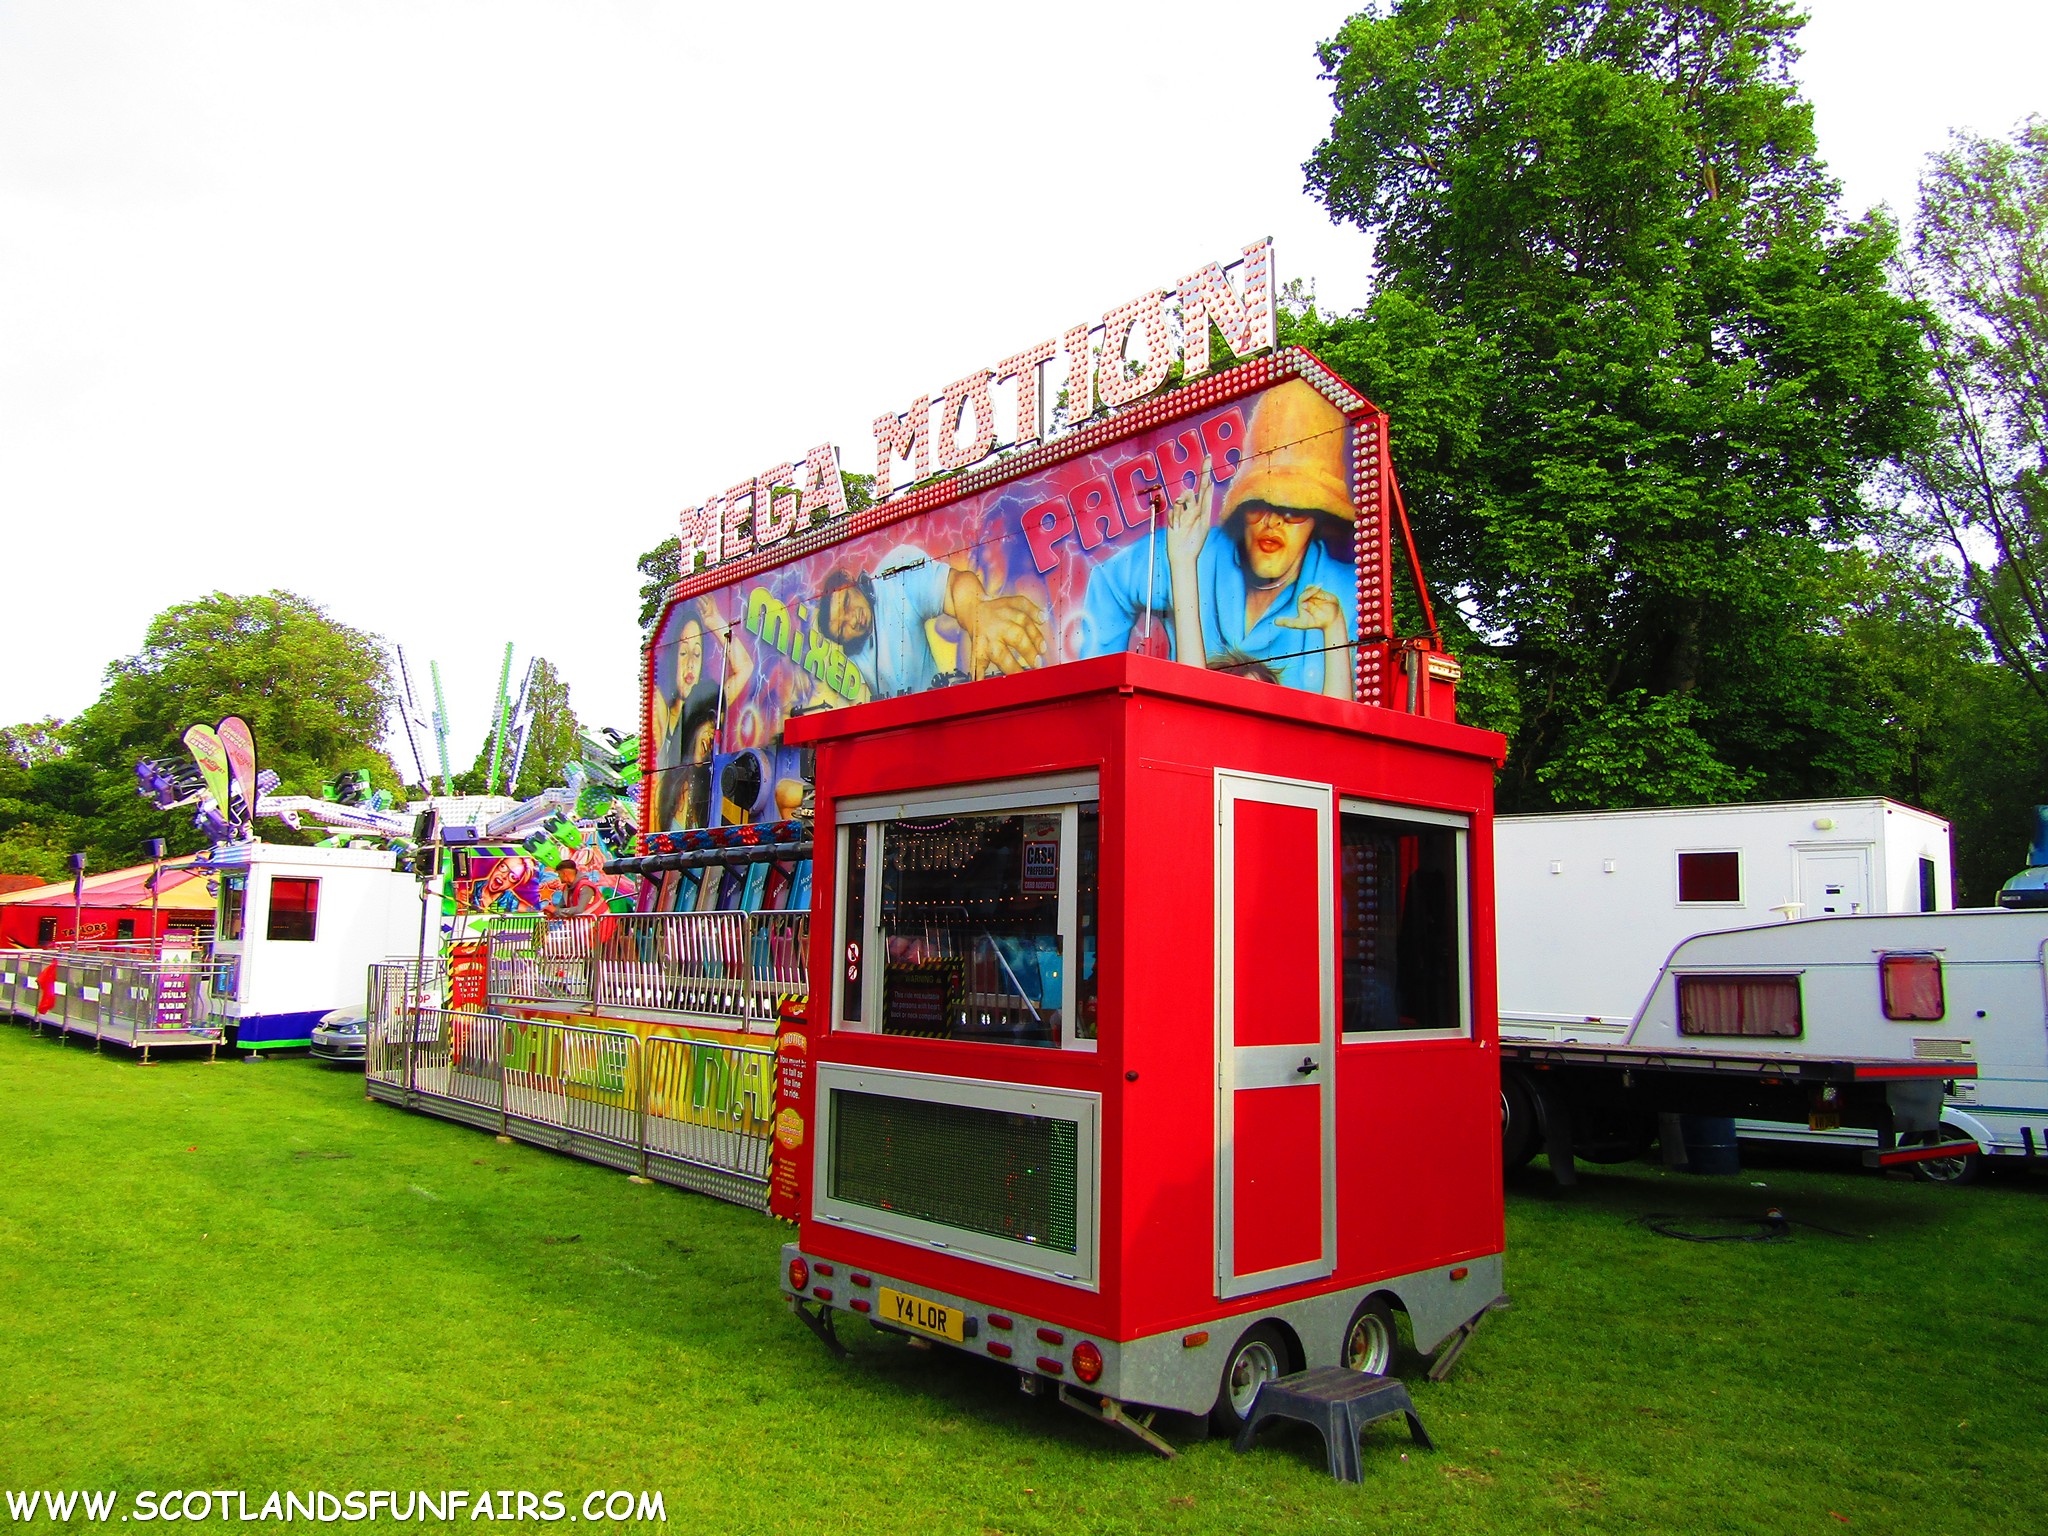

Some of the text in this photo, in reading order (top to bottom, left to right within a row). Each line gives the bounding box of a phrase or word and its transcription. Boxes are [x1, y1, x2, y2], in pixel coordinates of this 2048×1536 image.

[679, 236, 1278, 578] MEGA MOTION
[1021, 405, 1248, 575] PACHA
[1027, 847, 1055, 864] CASH
[1026, 866, 1054, 876] PREFERRED
[62, 923, 107, 937] TALORS
[783, 1033, 805, 1046] NOTICE
[780, 1055, 788, 1063] You
[783, 1077, 801, 1089] the line
[783, 1088, 788, 1096] to
[896, 1296, 947, 1333] Y4 LOR
